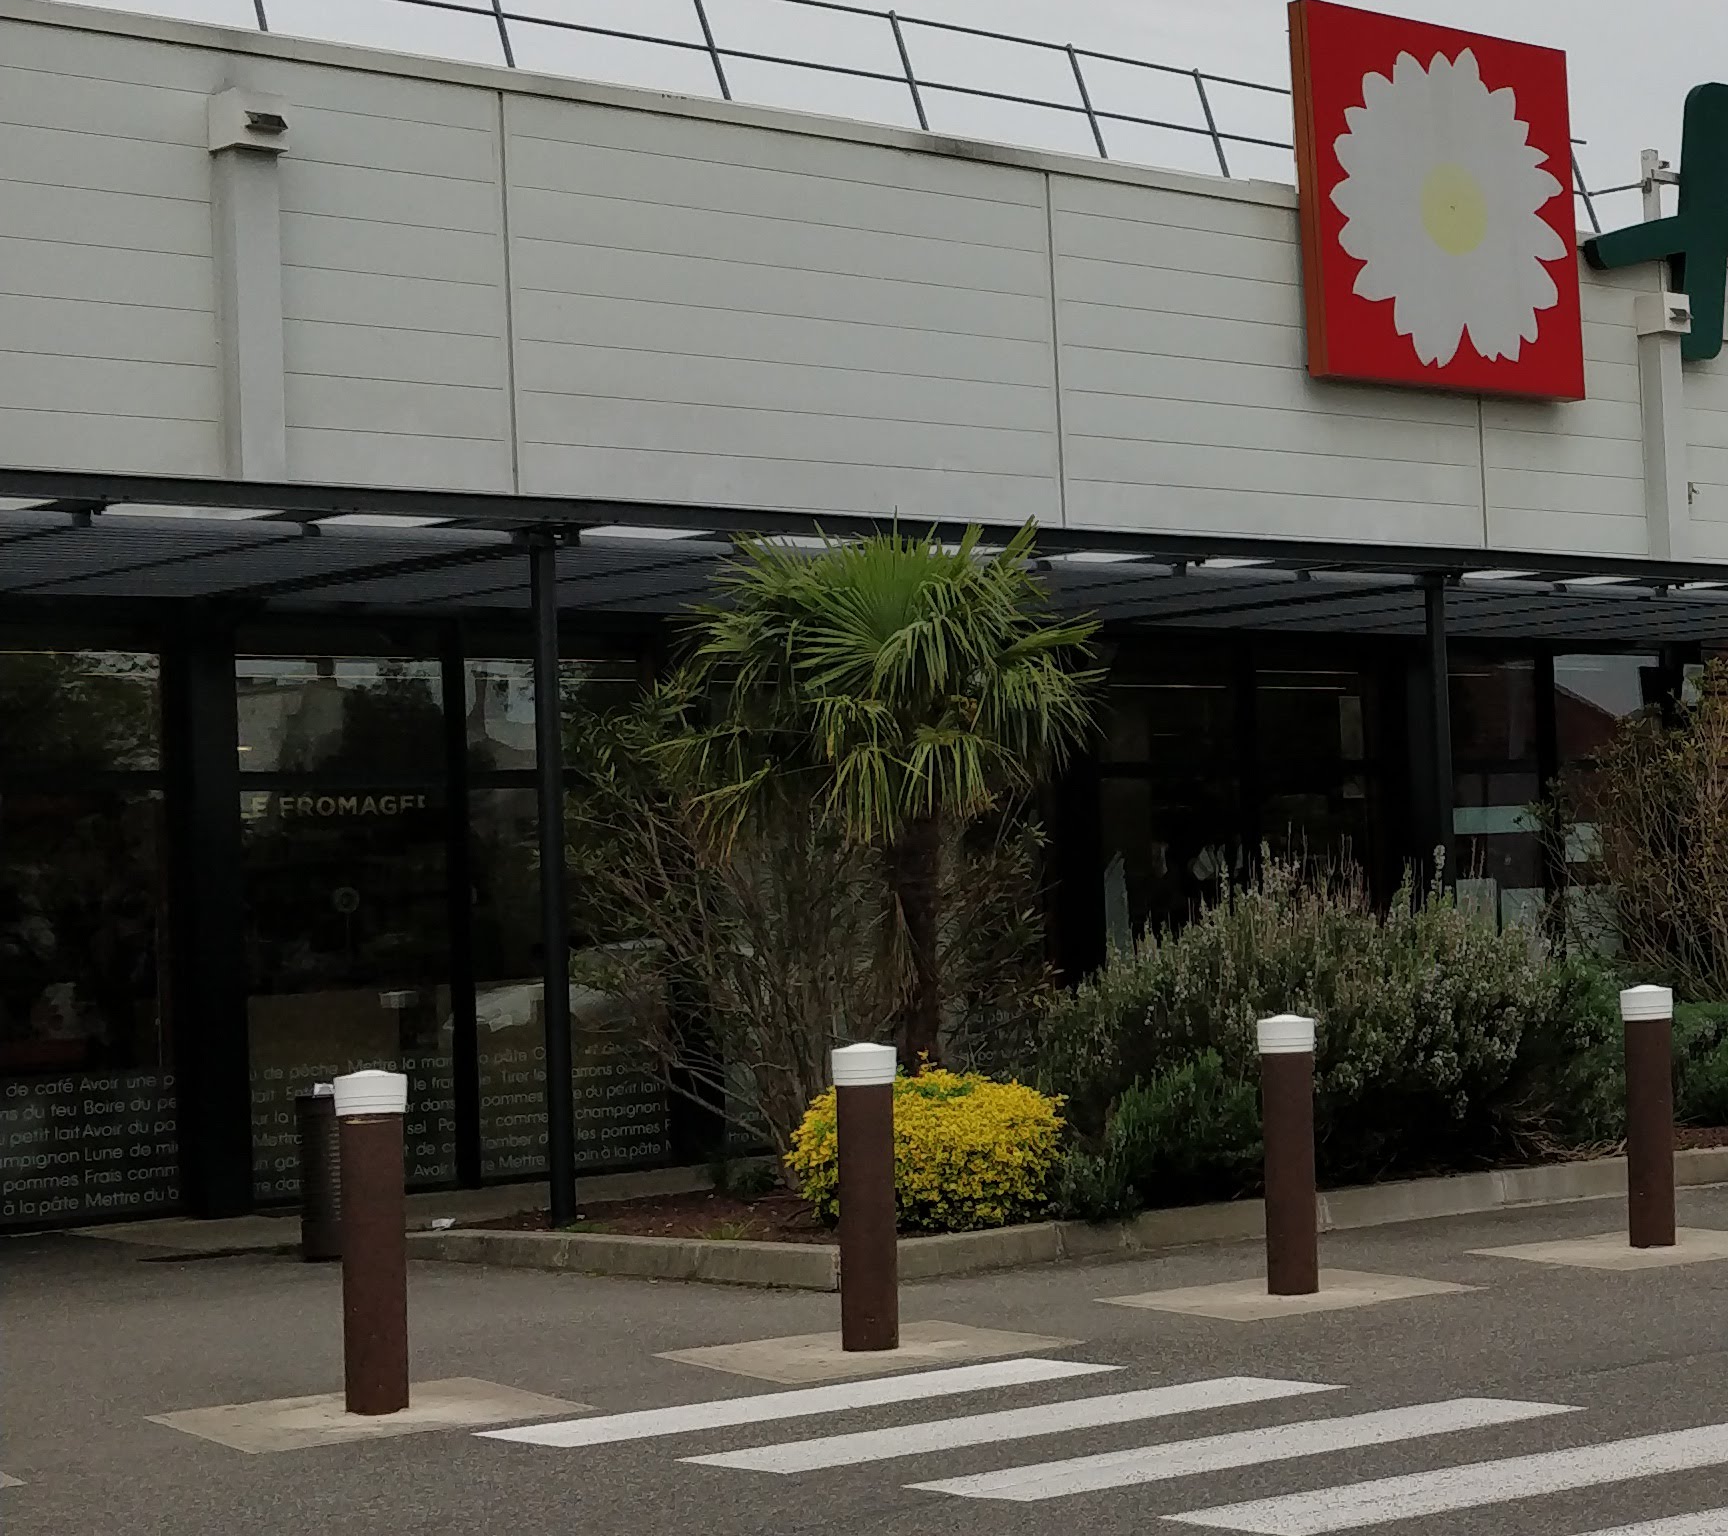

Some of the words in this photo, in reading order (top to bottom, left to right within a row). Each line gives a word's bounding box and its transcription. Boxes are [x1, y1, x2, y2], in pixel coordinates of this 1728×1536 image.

[572, 1065, 613, 1079] arrons
[5, 1083, 29, 1097] de
[35, 1077, 74, 1095] café
[80, 1076, 120, 1092] Avoir
[127, 1075, 158, 1089] une
[23, 1104, 45, 1121] du
[50, 1103, 77, 1117] feu
[84, 1099, 126, 1115] Boire
[130, 1097, 152, 1112] du
[574, 1101, 661, 1119] champignon
[10, 1127, 51, 1148] petit
[55, 1126, 80, 1141] lait
[82, 1123, 123, 1138] Avoir
[128, 1120, 149, 1135] du
[577, 1127, 596, 1141] les
[601, 1123, 661, 1141] pommes
[0, 1149, 80, 1170] mpignon
[84, 1147, 123, 1162] Lune
[130, 1143, 152, 1157] de
[413, 1163, 449, 1177] Avoir
[629, 1142, 661, 1160] pâte
[3, 1173, 80, 1196] pommes
[84, 1169, 123, 1184] Frais
[3, 1200, 15, 1216] à
[20, 1200, 35, 1214] la
[38, 1196, 79, 1216] pâte
[85, 1192, 141, 1208] Mettre
[144, 1187, 165, 1203] du
